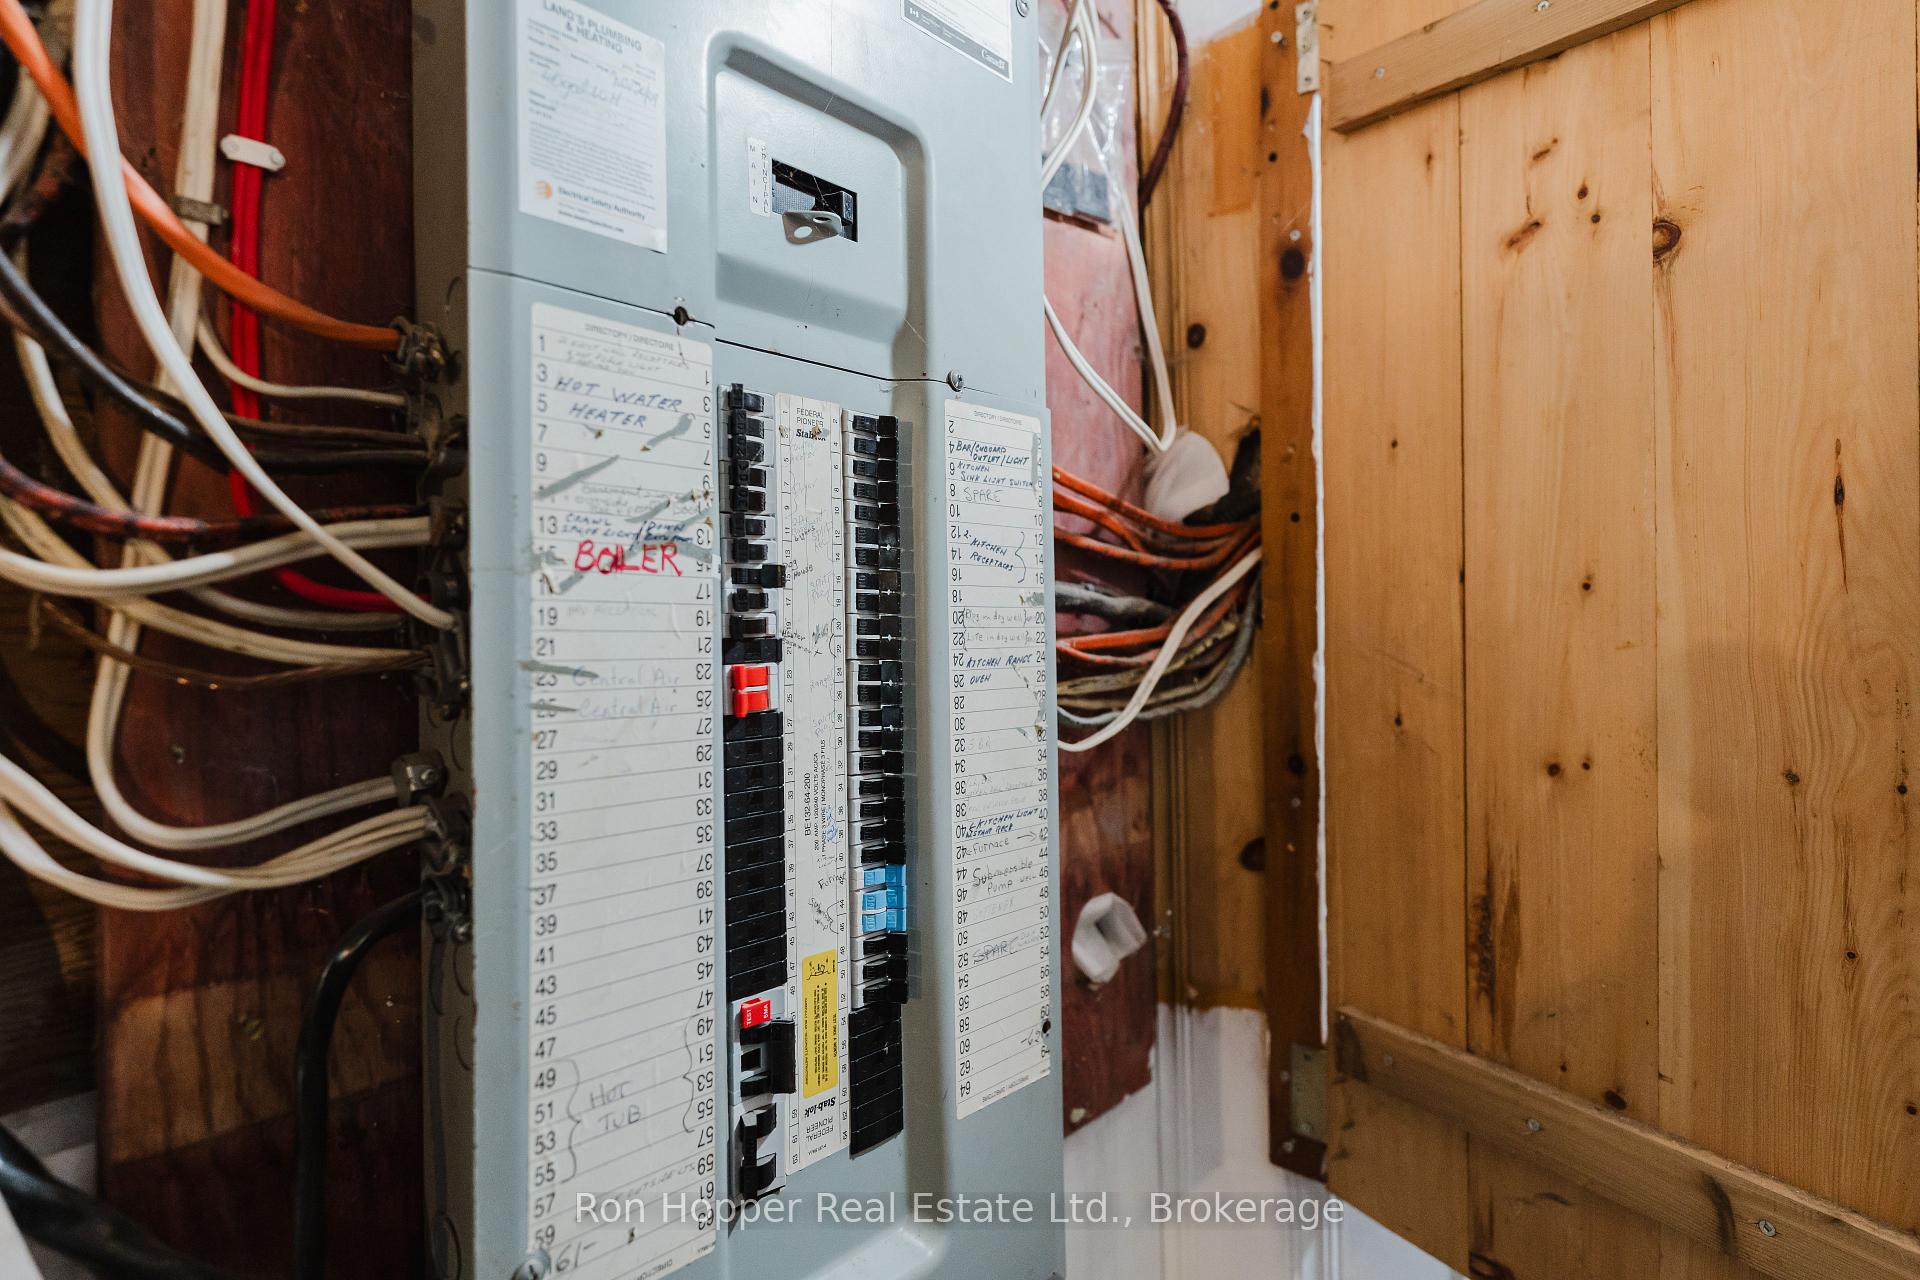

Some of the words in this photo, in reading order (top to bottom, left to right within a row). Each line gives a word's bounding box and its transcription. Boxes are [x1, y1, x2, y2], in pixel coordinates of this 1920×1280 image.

[576, 24, 623, 54] HEATING
[588, 13, 641, 52] PLUMBING
[539, 336, 545, 352] 1
[536, 367, 548, 382] 3
[555, 376, 600, 396] HOT
[612, 387, 682, 412] WATER
[537, 394, 548, 412] 5
[703, 396, 711, 413] 3
[568, 402, 647, 427] HEATER
[796, 408, 824, 420] FEDERAL
[537, 425, 547, 440] 7
[703, 423, 711, 439] 5
[949, 421, 954, 433] 2
[949, 442, 954, 453] 4
[536, 454, 547, 472] 9
[703, 450, 710, 466] 7
[957, 461, 990, 472] KITCHEN
[950, 484, 955, 496] 8
[963, 487, 1004, 503] SPARE
[950, 504, 960, 517] 10
[539, 517, 558, 535] 13
[1034, 515, 1043, 525] 10
[696, 528, 711, 545] 13
[951, 526, 960, 539] 12
[970, 538, 1008, 556] KITCHEN
[952, 569, 962, 581] 16
[1036, 573, 1044, 584] 16
[696, 584, 710, 600] 17
[697, 637, 712, 653] 21
[1036, 632, 1045, 644] 22
[953, 653, 963, 666] 24
[966, 657, 1002, 669] KITCHEN
[1036, 651, 1045, 662] 24
[969, 673, 992, 685] OVEN
[696, 691, 712, 707] 25
[954, 696, 964, 709] 28
[954, 717, 965, 730] 30
[537, 730, 557, 749] 27
[955, 739, 965, 752] 32
[696, 745, 712, 762] 29
[1037, 749, 1047, 761] 34
[955, 781, 966, 794] 36
[1038, 789, 1048, 802] 38
[536, 793, 556, 811] 31
[696, 798, 712, 816] 33
[956, 825, 966, 839] 40
[536, 852, 558, 872] 35
[696, 853, 713, 872] 37
[957, 888, 967, 902] 46
[1040, 886, 1048, 899] 48
[699, 908, 713, 925] 41
[536, 915, 557, 936] 39
[958, 954, 968, 968] 52
[697, 962, 713, 981] 45
[1040, 965, 1049, 979] 56
[536, 976, 557, 995] 43
[697, 1017, 713, 1036] 49
[959, 1018, 969, 1033] 58
[536, 1037, 556, 1058] 47
[697, 1071, 713, 1092] 53
[590, 1081, 632, 1109] HOT
[960, 1083, 970, 1097] 64
[535, 1102, 554, 1123] 51
[805, 1097, 836, 1118] Stab-lok
[599, 1104, 642, 1131] TUB
[806, 1116, 833, 1133] PIONEER
[806, 1125, 833, 1142] FEDERAL
[535, 1162, 556, 1187] 55
[536, 1225, 555, 1248] 59
